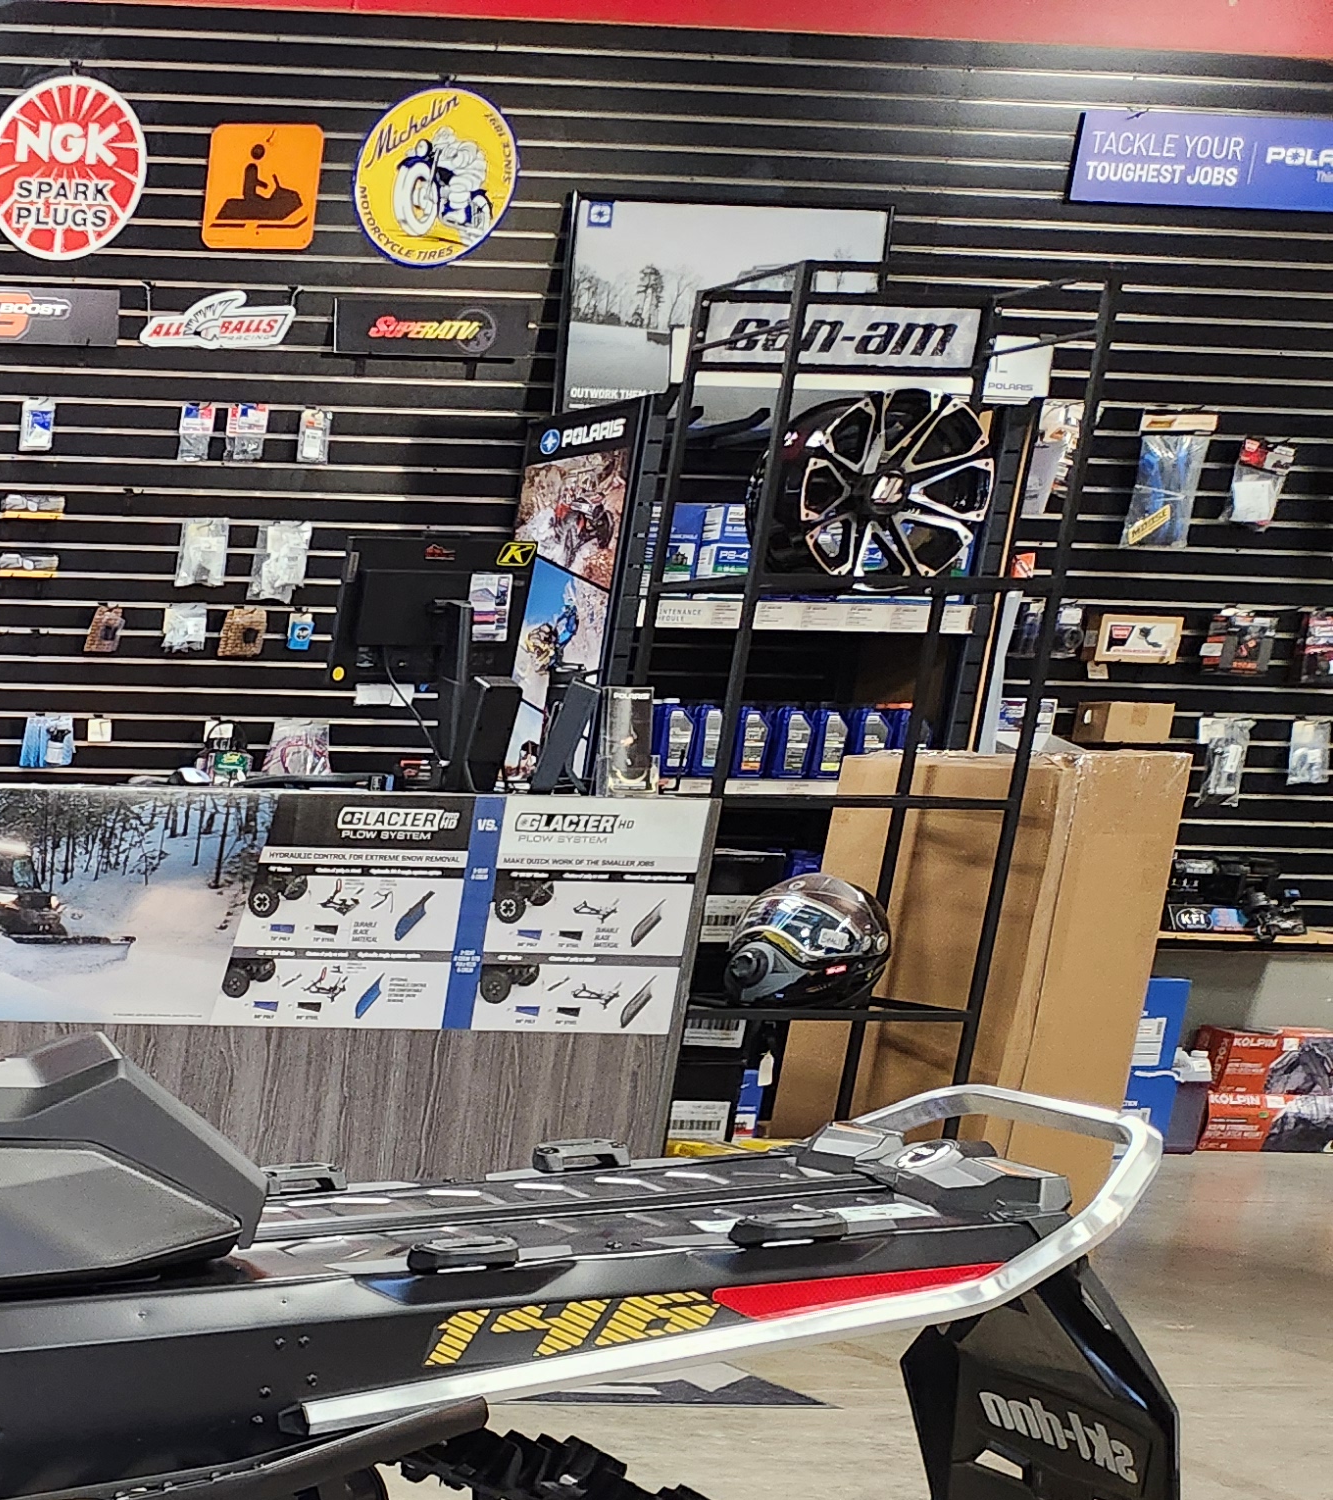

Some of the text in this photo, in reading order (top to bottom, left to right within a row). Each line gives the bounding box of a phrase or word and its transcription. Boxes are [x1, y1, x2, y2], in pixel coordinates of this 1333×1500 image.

[365, 95, 460, 169] Michelin
[15, 120, 121, 167] NGK
[1092, 130, 1245, 162] TACKLE YOUR
[1265, 146, 1333, 167] POLA
[1086, 161, 1239, 187] TOUGHEST JOBS
[16, 180, 110, 201] SPARK
[15, 206, 108, 227] PLUGS
[359, 185, 454, 261] MOTORCYCLE TIRES
[0, 303, 70, 317] BOOST
[148, 319, 279, 337] ALL BALLS
[570, 387, 619, 400] OUTWORK
[987, 382, 1034, 392] POLARIS
[561, 418, 627, 448] POLARIS
[351, 811, 437, 829] GLACIER
[477, 818, 498, 831] VS.
[526, 813, 635, 833] GLACIER HD
[341, 830, 431, 841] PLOW SYSTEM
[518, 835, 608, 844] PLOW SYSTEM
[268, 851, 312, 860] HYDRAULIC
[314, 852, 347, 860] CONTROL
[349, 853, 363, 861] FOR
[365, 854, 399, 862] EXTREME
[425, 855, 460, 863] REMOVAL
[1180, 911, 1208, 926] KFI
[1233, 1037, 1278, 1048] KOLPIN
[1208, 1093, 1261, 1106] KOLPIN
[423, 1290, 721, 1366] 146
